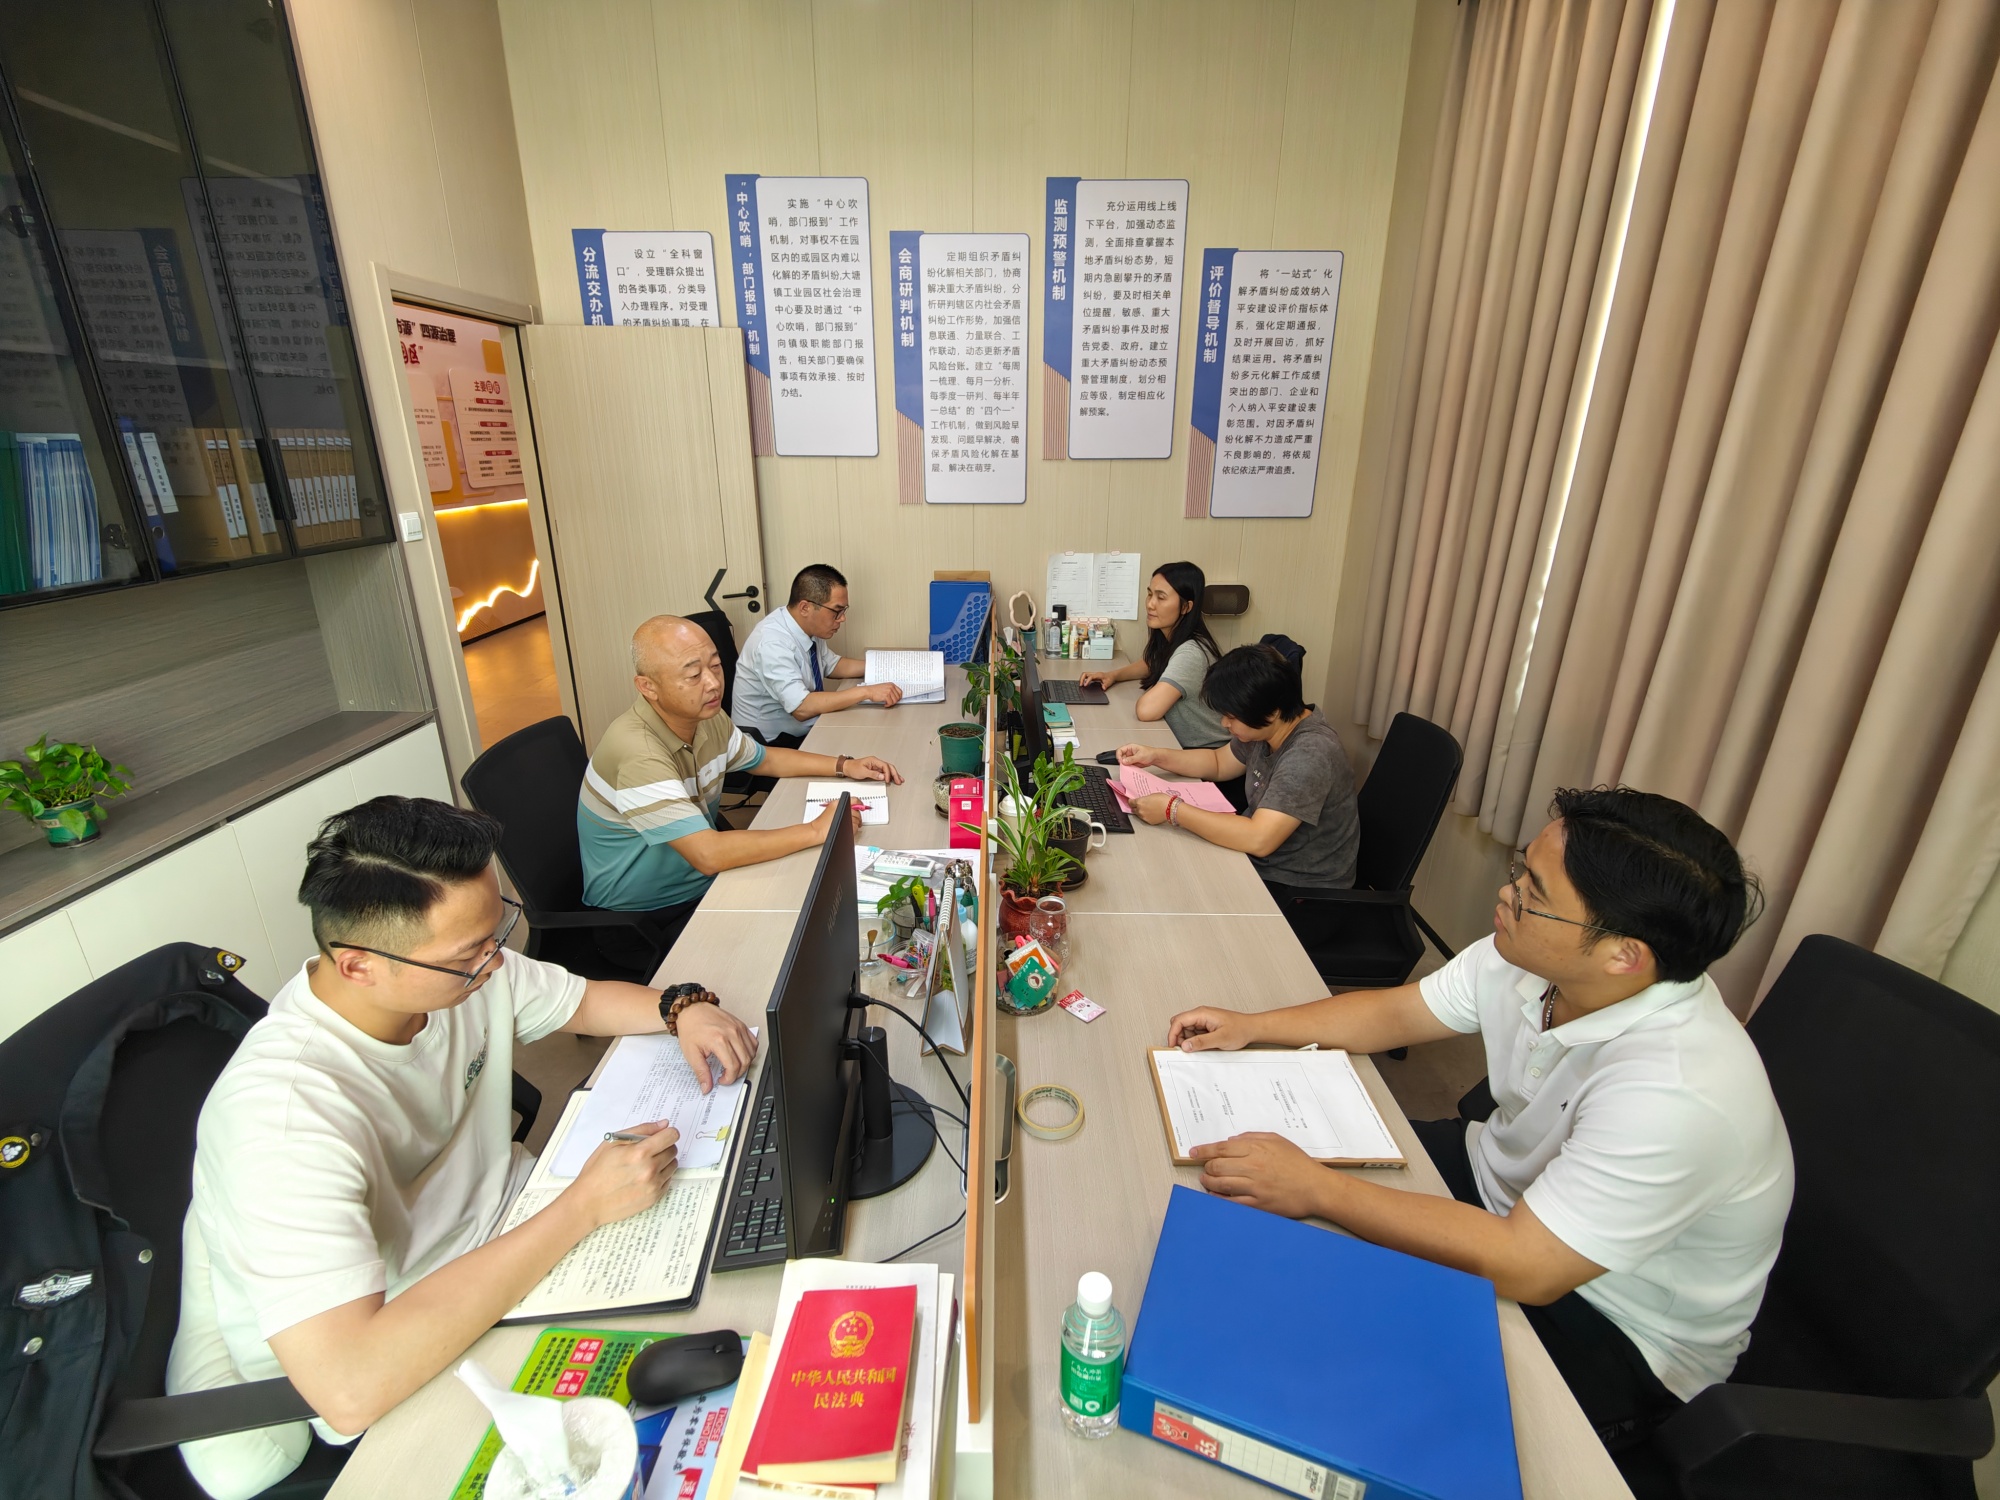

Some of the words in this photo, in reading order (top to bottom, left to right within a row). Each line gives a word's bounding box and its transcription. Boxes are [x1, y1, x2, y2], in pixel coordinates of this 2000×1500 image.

[1106, 200, 1177, 212] 充分运用线上线
[1052, 199, 1068, 301] 监测预警机制
[770, 252, 861, 263] 区内的或园区内难以
[946, 251, 1021, 262] 定期组织矛盾纠
[1083, 272, 1173, 284] 期内急剧攀升的矛盾
[772, 287, 862, 298] 镇工业园区社会治理
[1237, 285, 1331, 297] 解矛盾纠纷成效纳入
[898, 248, 915, 348] 会商研判机制
[927, 299, 1022, 310] 析研判辖区内社会矛盾
[1236, 303, 1329, 314] 平安建设评价指标体
[1203, 265, 1224, 363] 评价督导机制
[1081, 323, 1170, 335] 矛盾纠纷事件及时报
[777, 338, 864, 349] 向镇级职能部门报
[1081, 357, 1168, 368] 重大矛盾纠纷动态预
[1230, 370, 1321, 381] 纷多元化解工作成绩
[1227, 402, 1317, 413] 个人纳入平安建设表
[1224, 434, 1314, 445] 纷化解不力造成严重
[931, 448, 1020, 459] 保矛盾风险化解在基
[791, 1367, 897, 1388] 中华人民共和国
[814, 1391, 865, 1409] 民法典
[710, 1408, 728, 1441] THOSE
